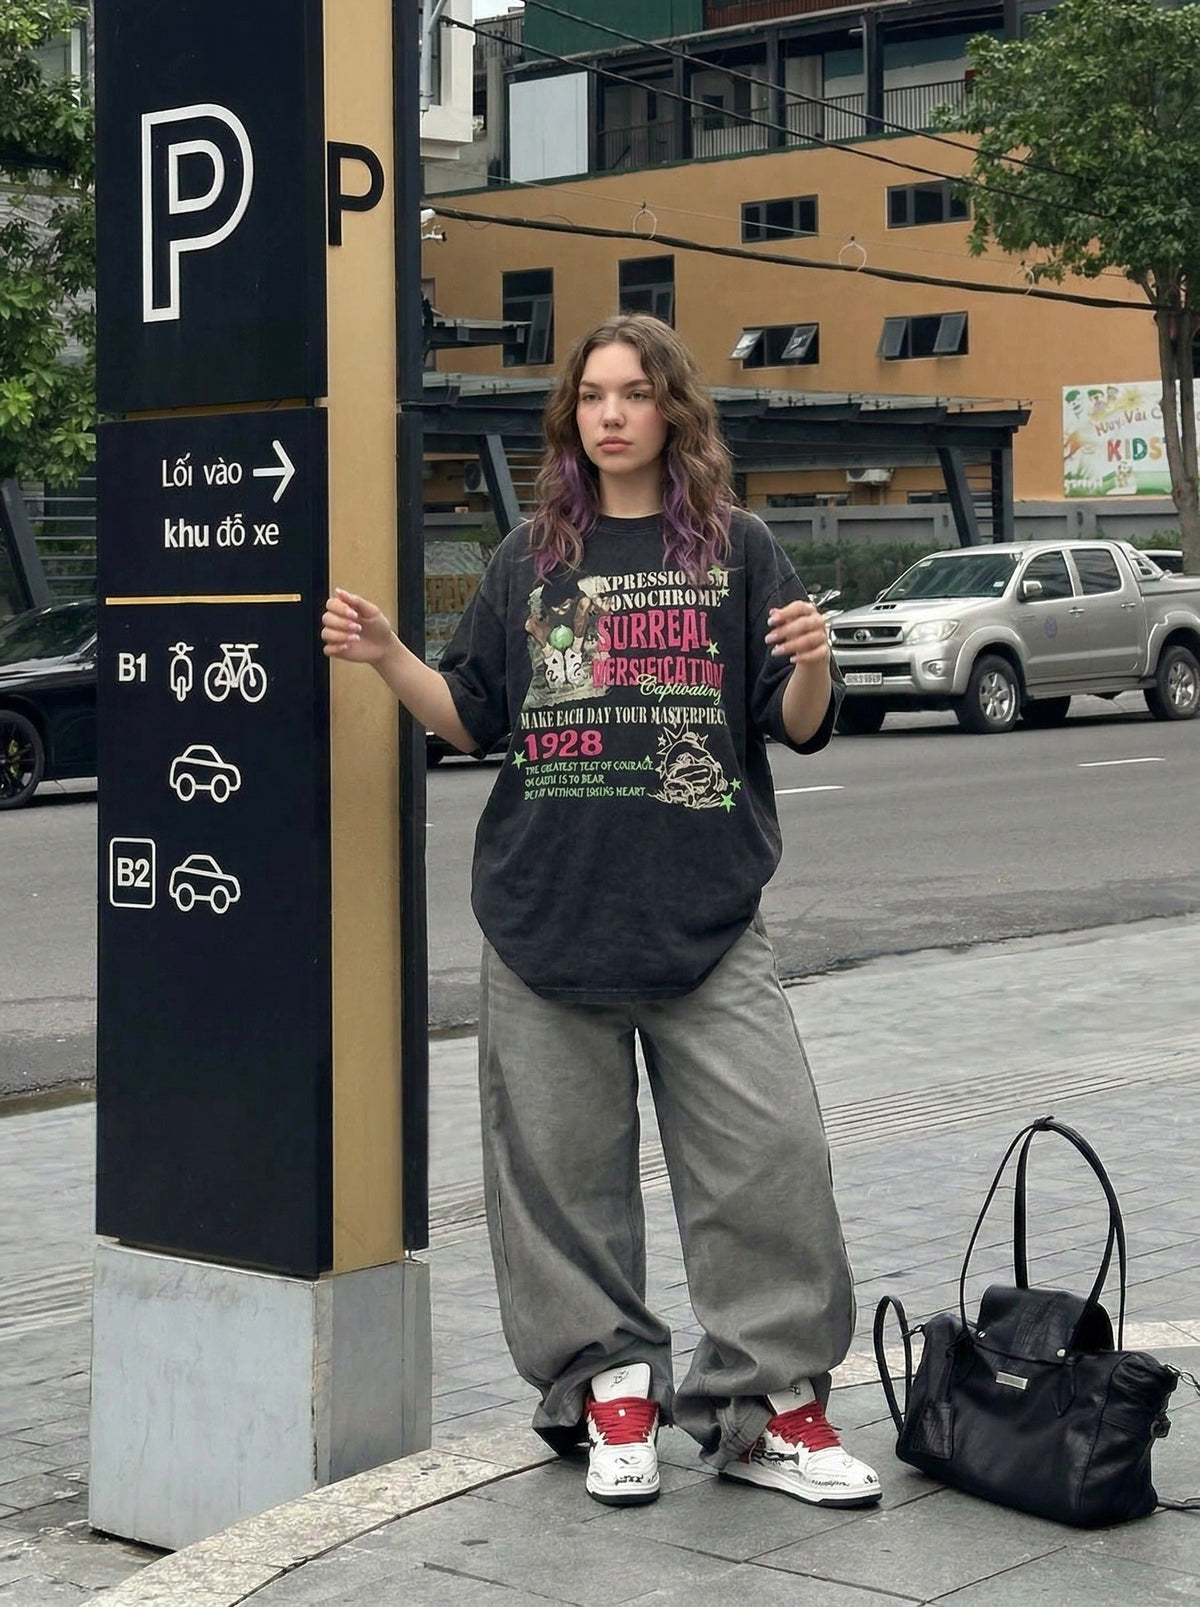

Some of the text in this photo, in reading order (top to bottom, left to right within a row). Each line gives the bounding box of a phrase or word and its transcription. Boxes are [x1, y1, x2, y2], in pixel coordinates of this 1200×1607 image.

[327, 141, 385, 246] P
[141, 103, 253, 323] P
[162, 452, 243, 488] Lối vào
[164, 513, 280, 548] khu đỗ xe
[604, 588, 722, 612] ONOCHROME
[597, 609, 712, 653] SURREAL
[118, 652, 147, 682] B1
[520, 706, 728, 730] MAKE EACH DAY YOUR MASTERPIEC
[524, 729, 603, 761] 1928
[559, 774, 568, 784] IS
[568, 774, 580, 784] TO
[581, 774, 605, 784] BEAR
[580, 761, 600, 771] TEST
[600, 761, 612, 771] OF
[613, 760, 654, 771] COURAGE
[616, 786, 646, 797] HEART
[117, 857, 151, 888] B2
